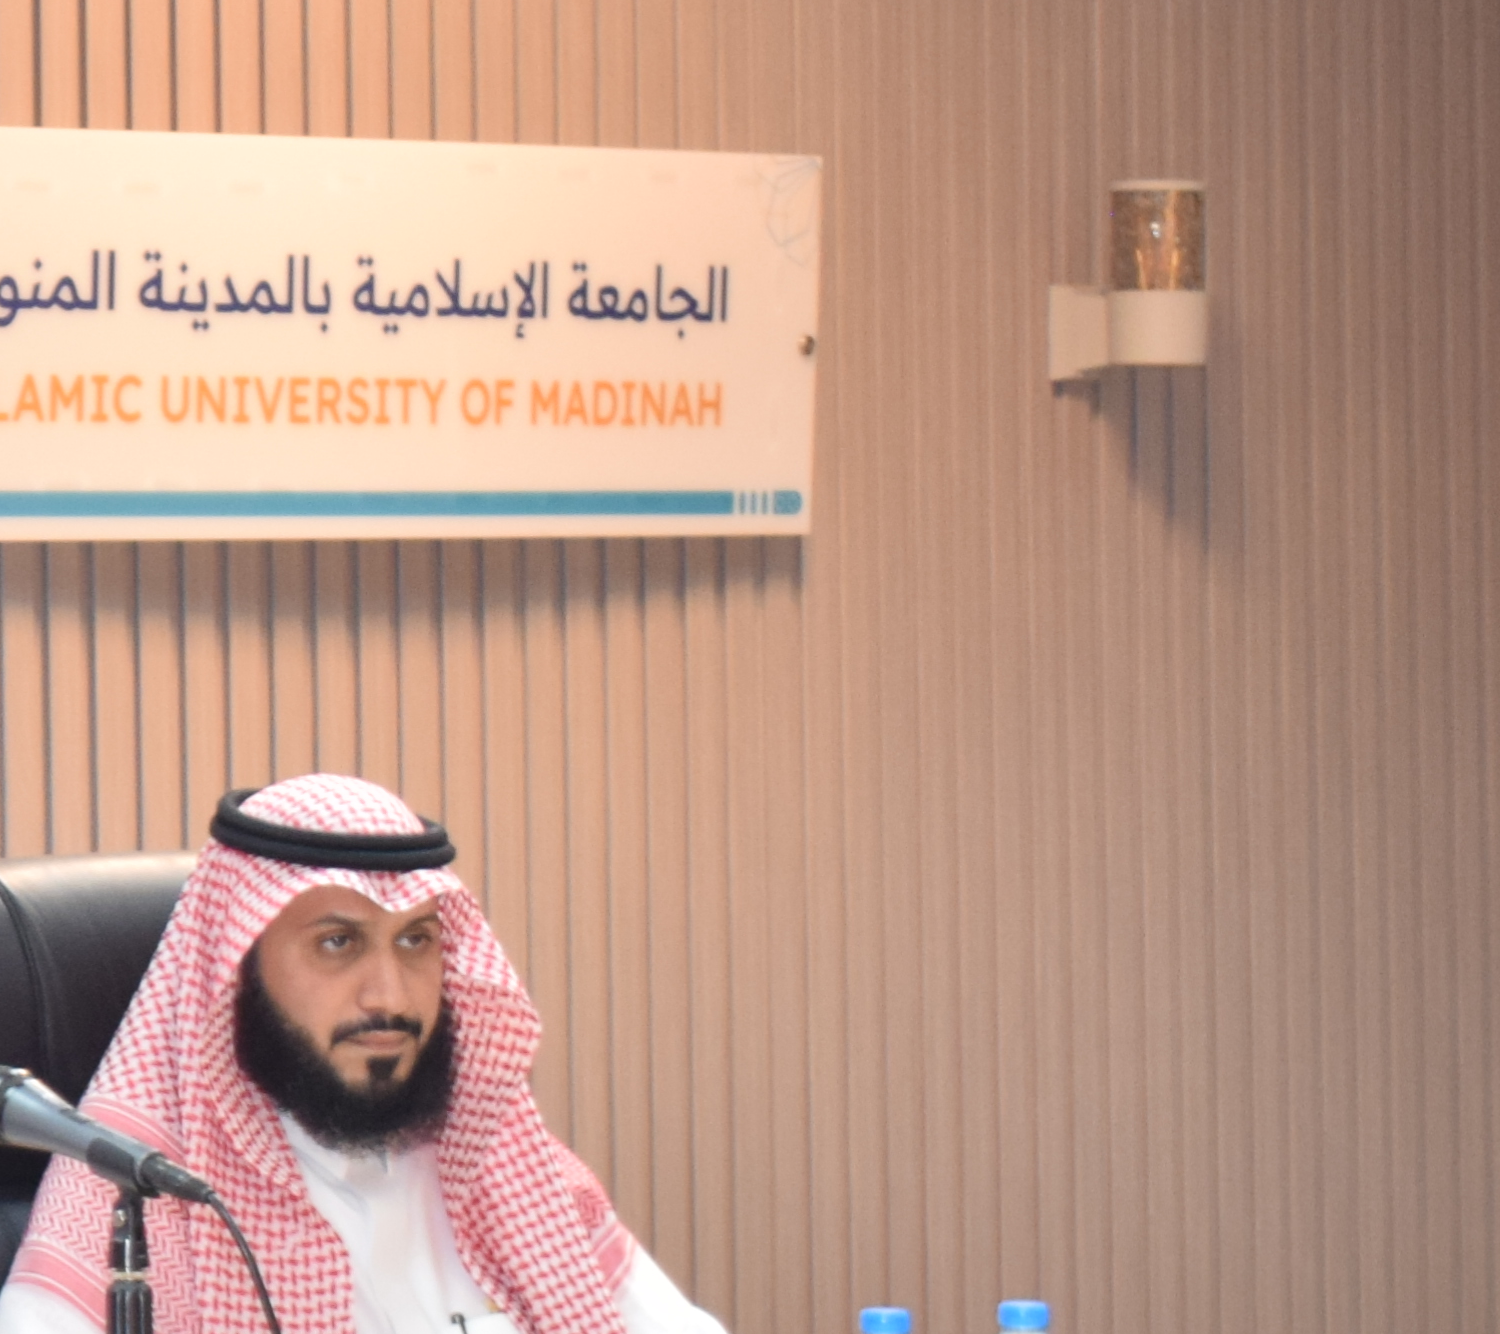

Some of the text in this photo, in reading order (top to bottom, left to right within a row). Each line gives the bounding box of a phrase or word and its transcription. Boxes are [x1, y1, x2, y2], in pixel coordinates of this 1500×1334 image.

[139, 250, 332, 334] بالمدينة
[353, 255, 549, 339] الإسلامية
[568, 262, 729, 340] الجامعة
[159, 373, 448, 427] UNIVERSITY
[460, 378, 516, 427] OF
[529, 380, 723, 428] MADINAH
